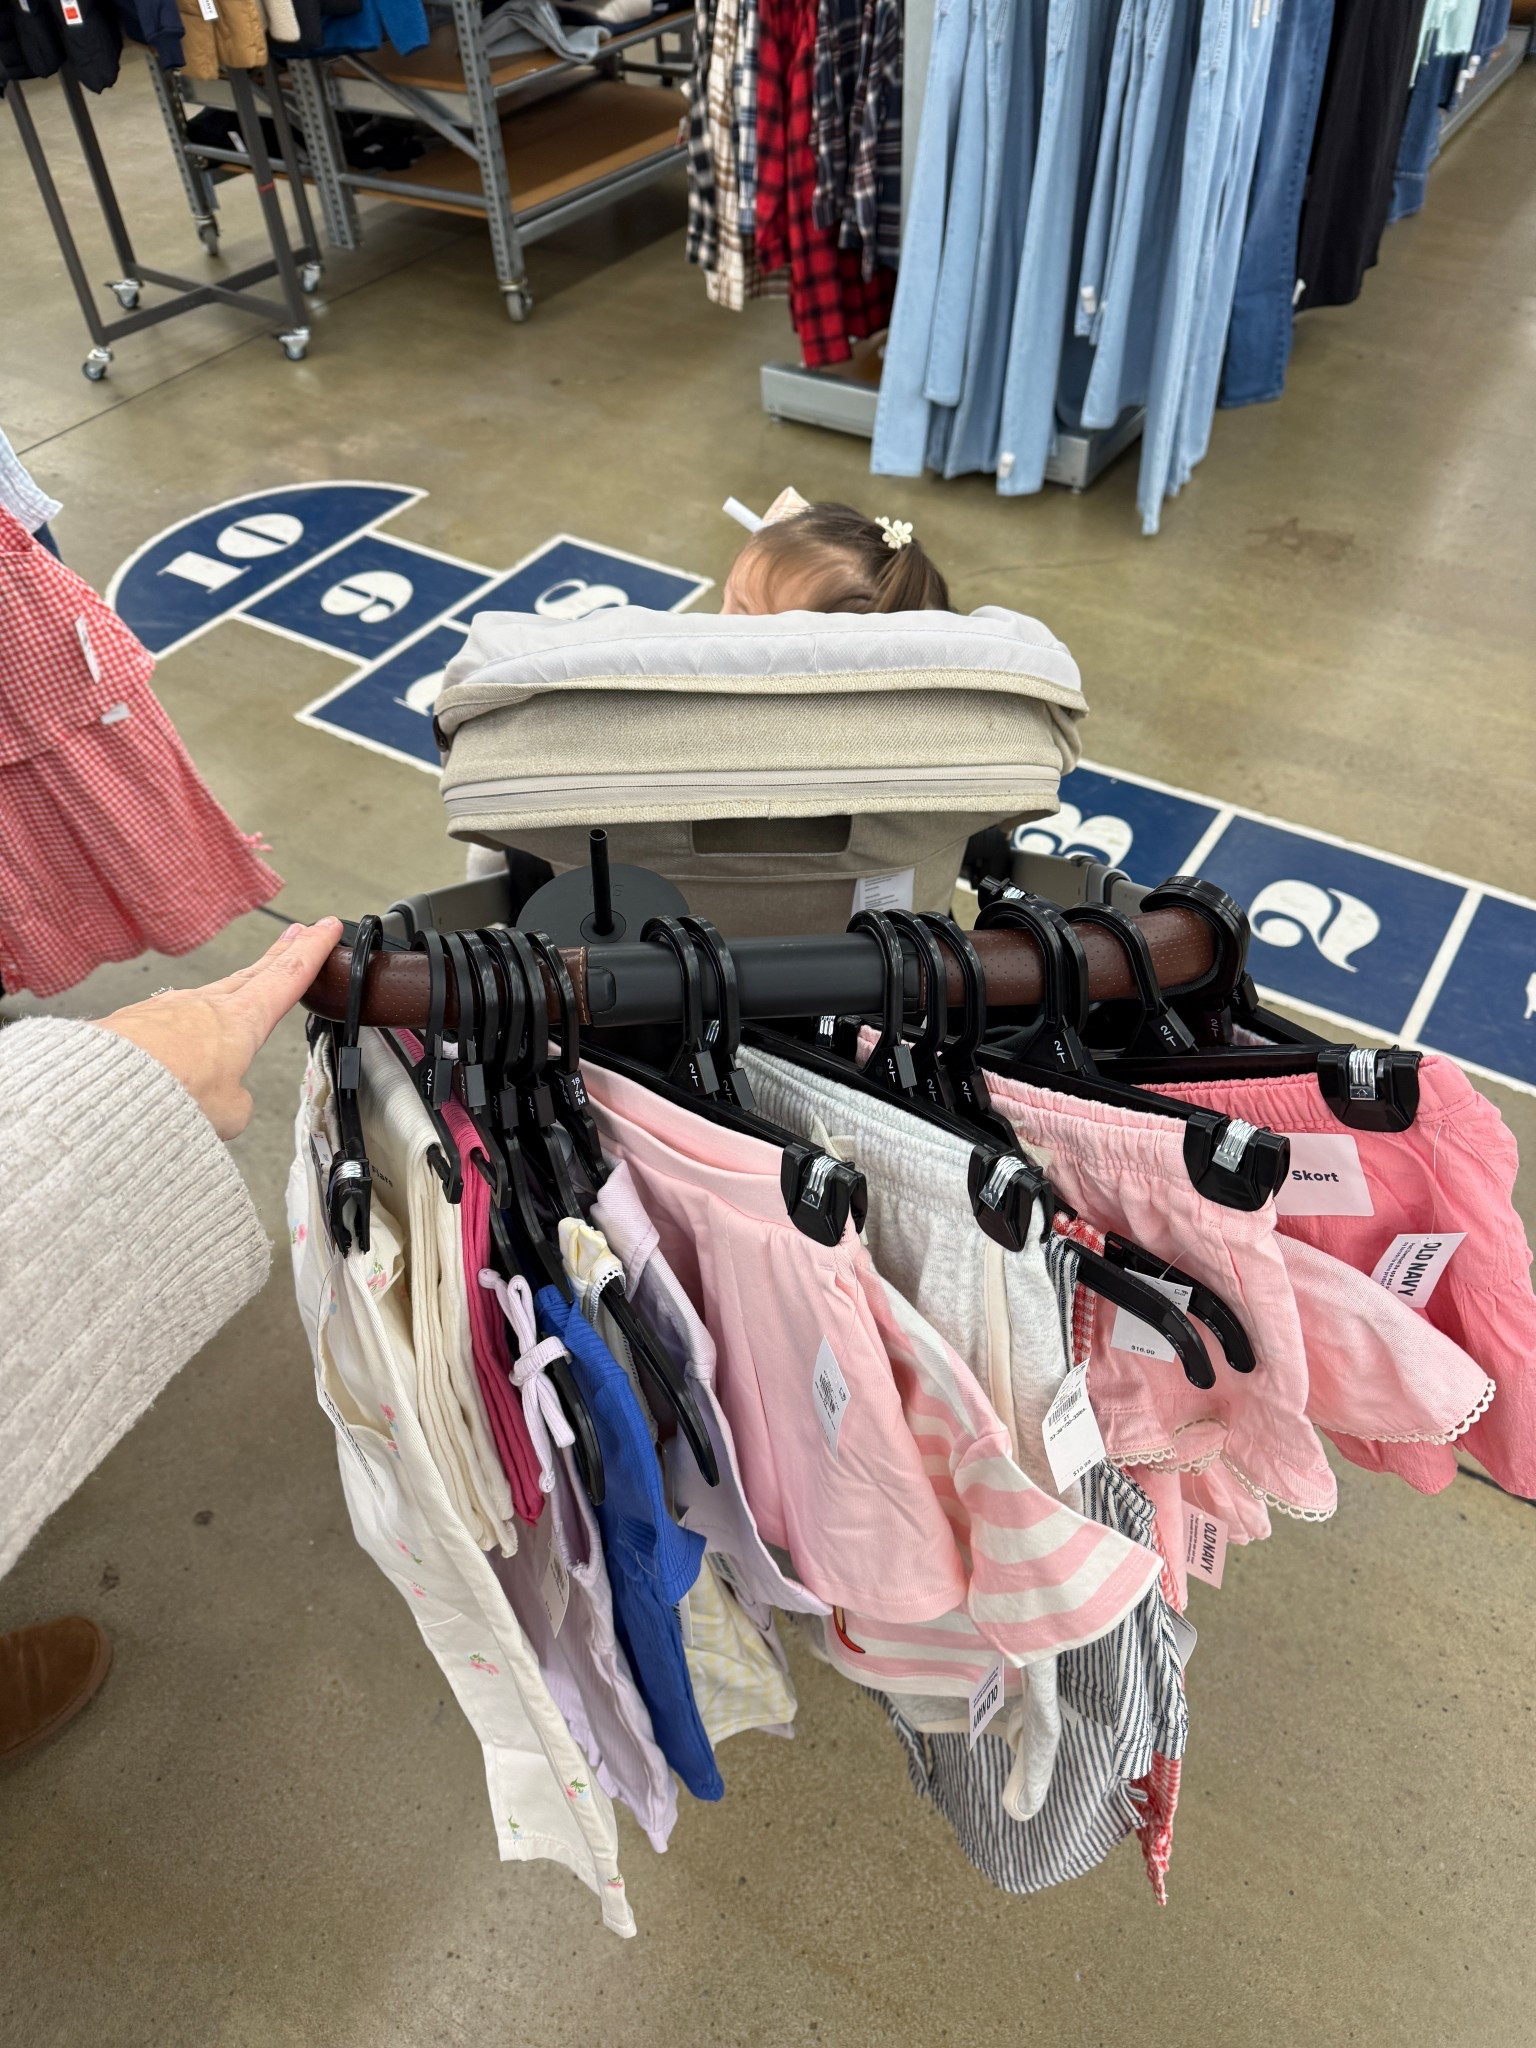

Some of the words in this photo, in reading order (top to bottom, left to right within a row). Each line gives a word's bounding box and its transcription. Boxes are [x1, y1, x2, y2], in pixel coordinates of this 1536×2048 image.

[156, 513, 304, 594] 10
[321, 570, 414, 623] 9
[1248, 879, 1381, 973] 2
[1291, 1170, 1340, 1183] Skort
[1414, 1242, 1443, 1261] OLD
[1397, 1262, 1429, 1297] NAVY
[1204, 1522, 1217, 1544] OLD
[1200, 1541, 1217, 1575] NAVY
